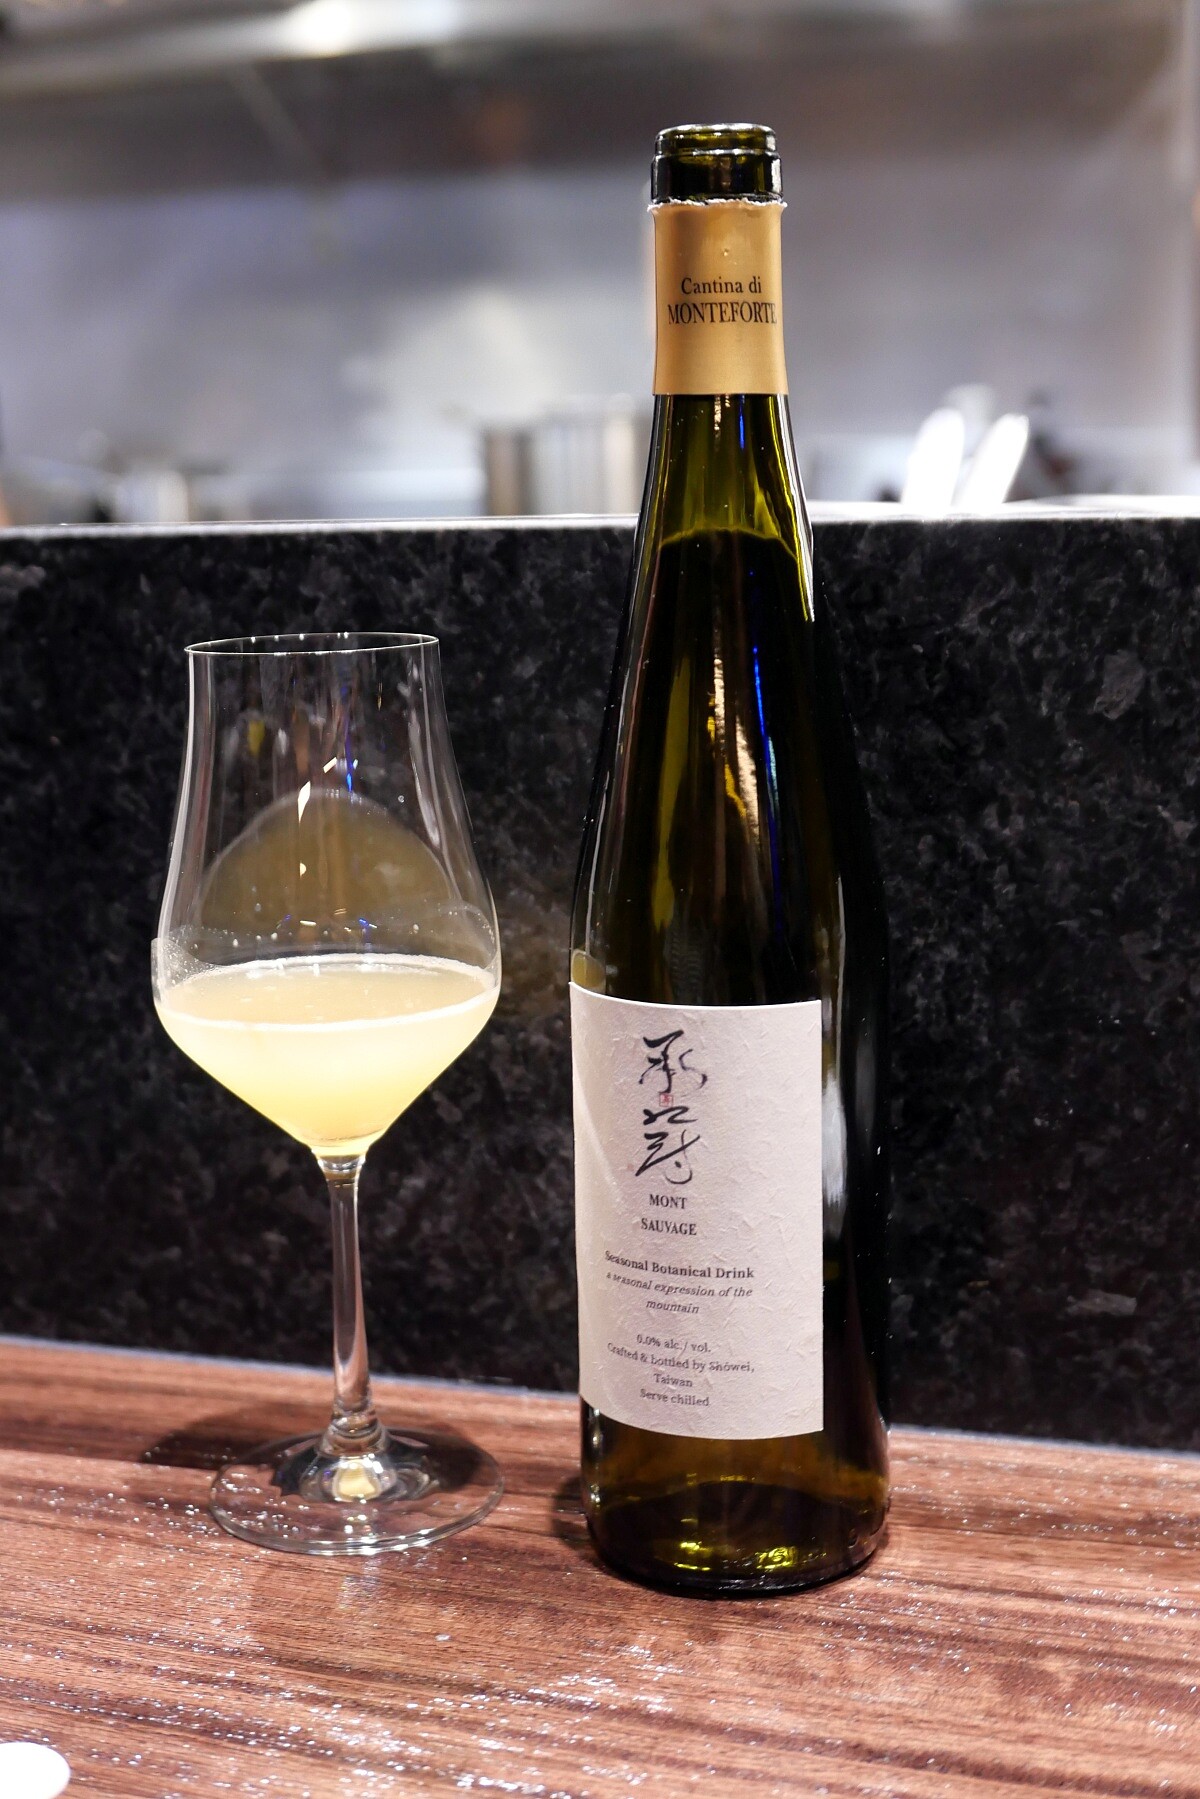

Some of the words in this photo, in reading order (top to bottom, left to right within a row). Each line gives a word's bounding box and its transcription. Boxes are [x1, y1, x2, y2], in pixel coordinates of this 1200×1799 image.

[680, 276, 744, 295] Cantina
[749, 275, 763, 294] di
[667, 300, 778, 325] MONTEFORTE
[649, 1193, 688, 1210] MONT
[640, 1217, 697, 1236] SAUVAGE
[604, 1250, 649, 1272] Seasonal
[651, 1262, 712, 1278] Botanical
[715, 1267, 755, 1279] Drink
[606, 1271, 612, 1279] a
[613, 1274, 653, 1291] seasonal
[654, 1284, 715, 1297] expression
[718, 1286, 732, 1297] of
[733, 1288, 753, 1298] the
[645, 1300, 700, 1314] mountain
[636, 1334, 662, 1347] 0.0%
[690, 1342, 712, 1352] vol.
[607, 1342, 639, 1361] Crafted
[640, 1352, 649, 1363] &
[651, 1354, 690, 1369] bottled
[692, 1358, 706, 1373] by
[653, 1373, 694, 1388] Taiwan
[639, 1388, 669, 1403] Serve
[670, 1394, 710, 1407] chilled
